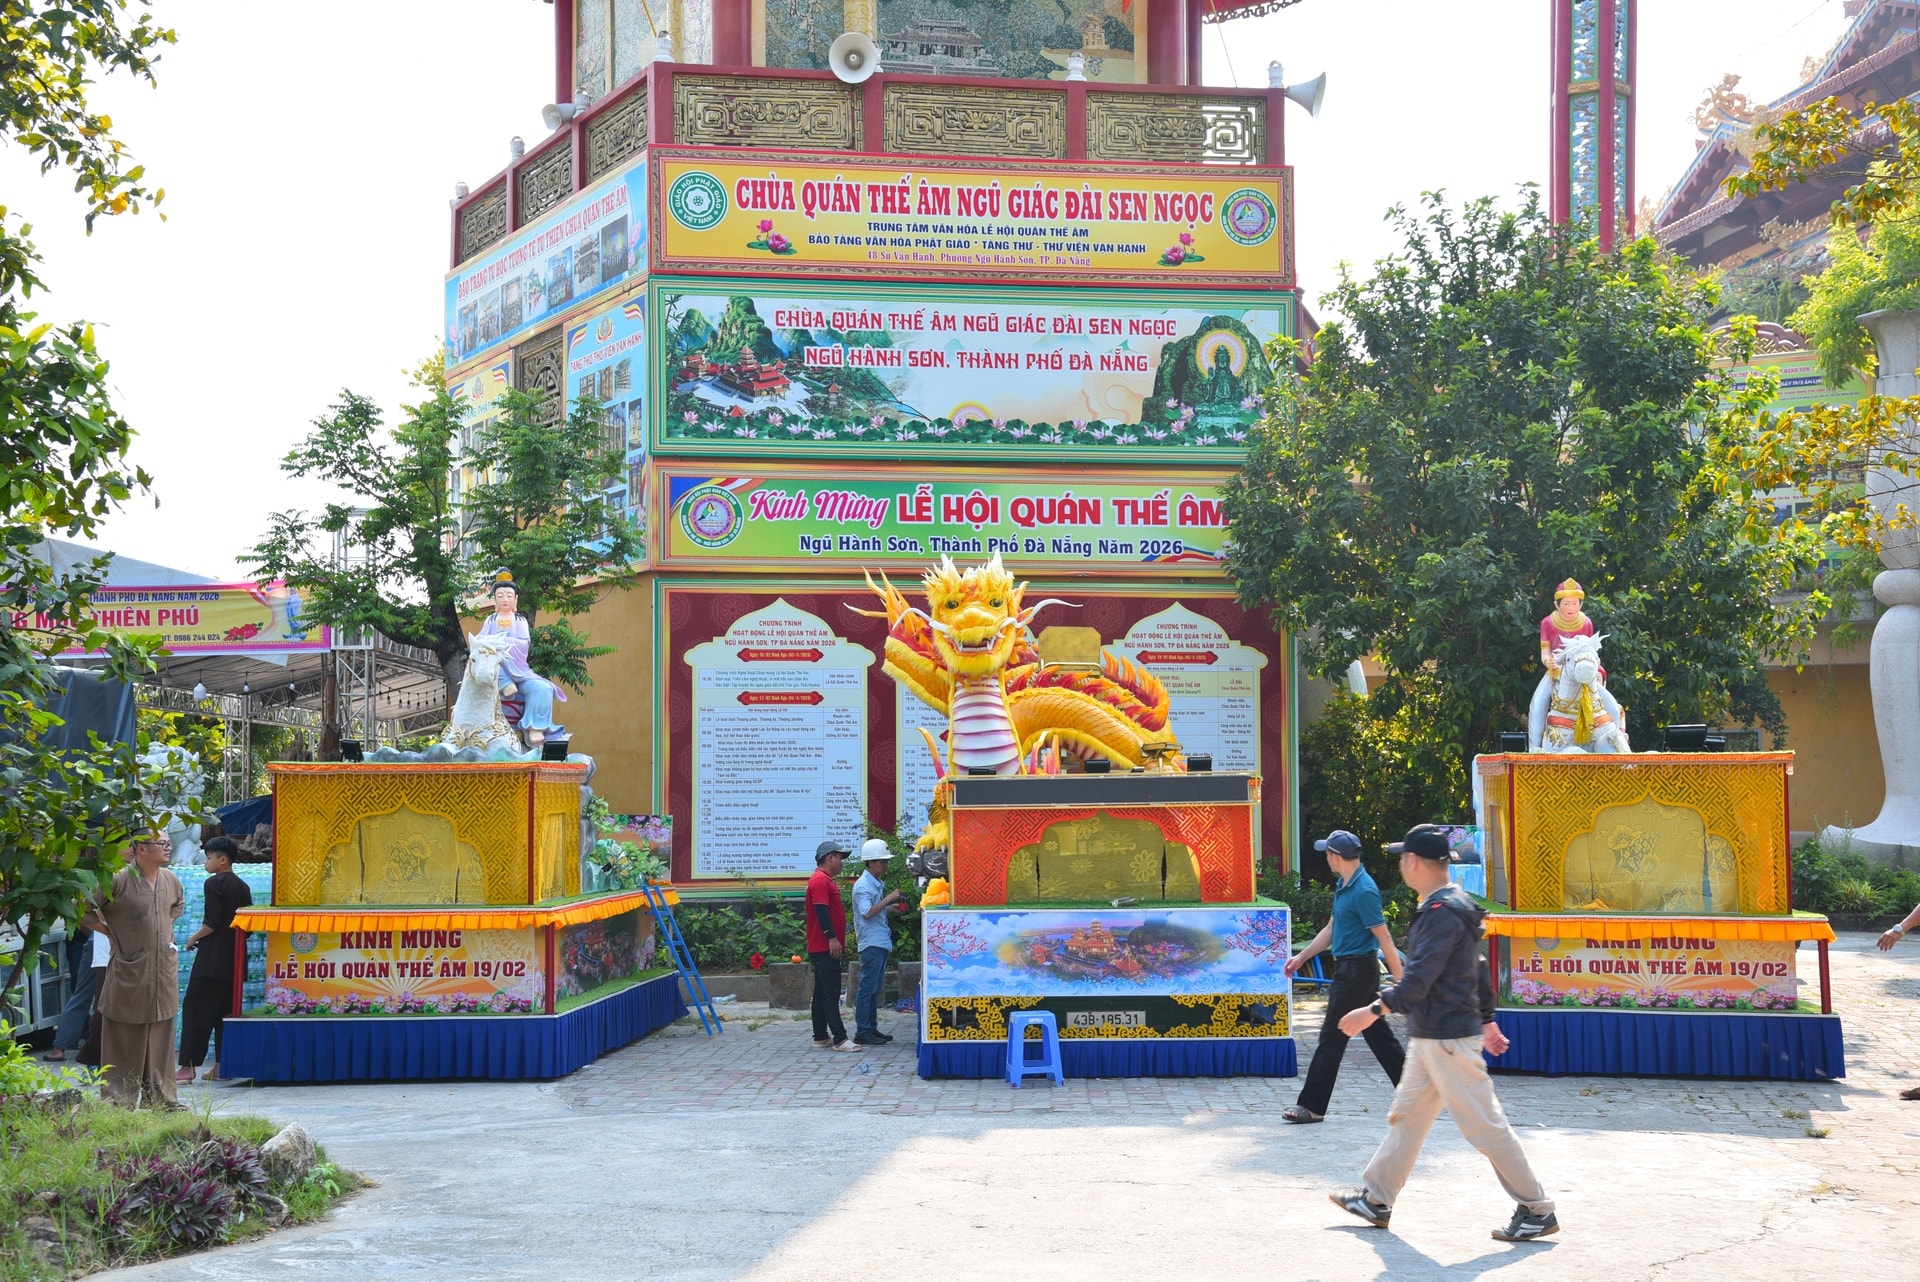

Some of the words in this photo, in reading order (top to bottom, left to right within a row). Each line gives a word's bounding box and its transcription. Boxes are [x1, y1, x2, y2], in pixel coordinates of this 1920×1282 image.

[736, 173, 796, 211] CHÙA
[802, 175, 861, 219] QUÁN
[867, 174, 911, 215] THẾ
[917, 179, 951, 216] ÂM
[957, 181, 1002, 219] NGŨ
[1008, 183, 1059, 220] GIÁC
[1065, 183, 1103, 221] ĐÀI
[1109, 191, 1148, 222] SEN
[1153, 193, 1213, 230] NGỌC
[867, 222, 903, 232] TRUNG
[906, 221, 929, 233] TÂM
[932, 222, 954, 234] VĂN
[957, 223, 978, 235] HÓA
[981, 223, 993, 235] LỄ
[997, 225, 1014, 238] HỘI
[1017, 225, 1047, 237] QUÁN
[1049, 226, 1069, 238] THẾ
[1072, 227, 1089, 238] ÂM
[808, 232, 830, 245] BẢO
[833, 234, 862, 246] TÀNG
[865, 236, 887, 247] VĂN
[890, 236, 912, 248] HÓA
[915, 237, 942, 250] PHẬT
[945, 238, 971, 249] GIÁO
[982, 239, 1009, 251] TÀNG
[1013, 241, 1033, 251] THƯ
[1043, 242, 1064, 252] THƯ
[1066, 241, 1090, 254] VIỆN
[1093, 243, 1114, 255] VẠN
[1117, 244, 1146, 256] HẠNH
[867, 250, 878, 260] 48
[775, 307, 826, 328] CHÙA
[832, 309, 883, 332] QUÁN
[888, 308, 925, 331] THẾ
[930, 311, 957, 332] ÂM
[963, 312, 999, 333] NGŨ
[1006, 313, 1047, 334] GIÁC
[1052, 313, 1083, 334] ĐÀI
[1089, 318, 1122, 335] SEN
[1129, 319, 1176, 340] NGỌC
[806, 345, 843, 365] NGŨ
[849, 345, 902, 367] HÀNH
[957, 348, 1019, 370] THÀNH
[1026, 348, 1063, 370] PHỐ
[1069, 350, 1093, 371] ĐÀ
[1100, 348, 1148, 372] NẴNG
[749, 491, 810, 521] Kính
[814, 491, 890, 529] Mừng
[899, 484, 932, 522] LỄ
[943, 491, 998, 530] HỘI
[1010, 493, 1101, 528] QUÁN
[1112, 490, 1170, 526] THẾ
[1179, 494, 1231, 526] ÂM
[799, 535, 832, 554] Ngũ
[838, 534, 882, 551] Hành
[887, 536, 924, 554] Sơn,
[930, 536, 981, 553] Thành
[988, 533, 1019, 553] Phố
[1024, 537, 1045, 554] Đà
[1052, 535, 1093, 557] Nẵng
[1098, 539, 1133, 555] Năm
[1139, 540, 1183, 556] 2026
[199, 591, 219, 601] 2026
[91, 605, 150, 628] THIÊN
[158, 604, 199, 626] PHÚ
[174, 634, 191, 642] 0986
[275, 955, 298, 978] LỄ
[304, 958, 335, 982] HỘI
[342, 957, 390, 980] QUÁN
[396, 954, 434, 977] THẾ
[440, 957, 466, 978] ÂM
[474, 961, 526, 981] 19/02
[1518, 952, 1543, 973] LỄ
[1549, 955, 1582, 977] HỘI
[1589, 956, 1640, 975] QUÁN
[1647, 955, 1687, 975] THẾ
[1693, 957, 1723, 976] ÂM
[1730, 961, 1787, 980] 19/02
